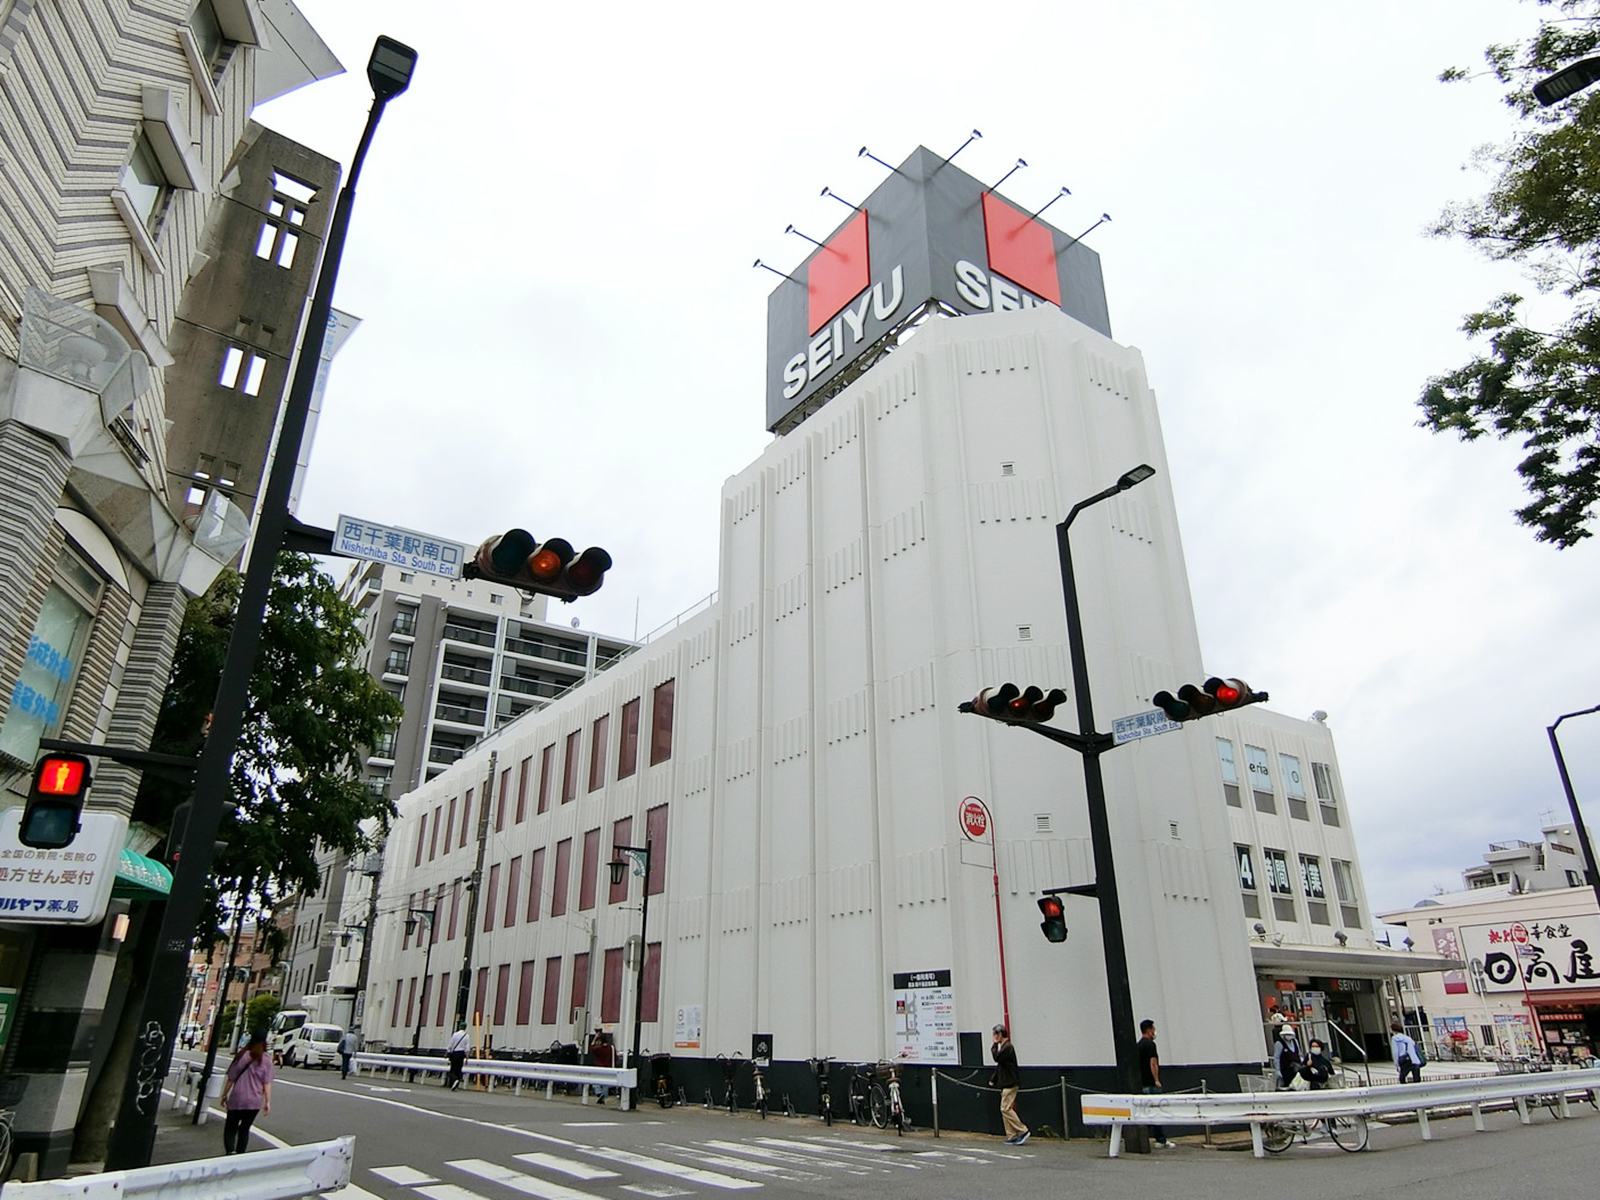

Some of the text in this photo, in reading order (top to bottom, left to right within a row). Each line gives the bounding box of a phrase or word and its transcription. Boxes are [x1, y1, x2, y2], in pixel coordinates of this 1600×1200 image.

[782, 264, 904, 399] SEIYU
[344, 521, 458, 564] 西千葉駅南口
[341, 540, 454, 575] Nishichiba Sta. South Ent.
[1115, 711, 1168, 733] 西千葉駅南
[1, 849, 97, 863] 全国の病院・医院の
[0, 898, 79, 914] ルヤマ薬局
[1484, 939, 1600, 984] 日高屋
[1337, 979, 1361, 992] SEIYU
